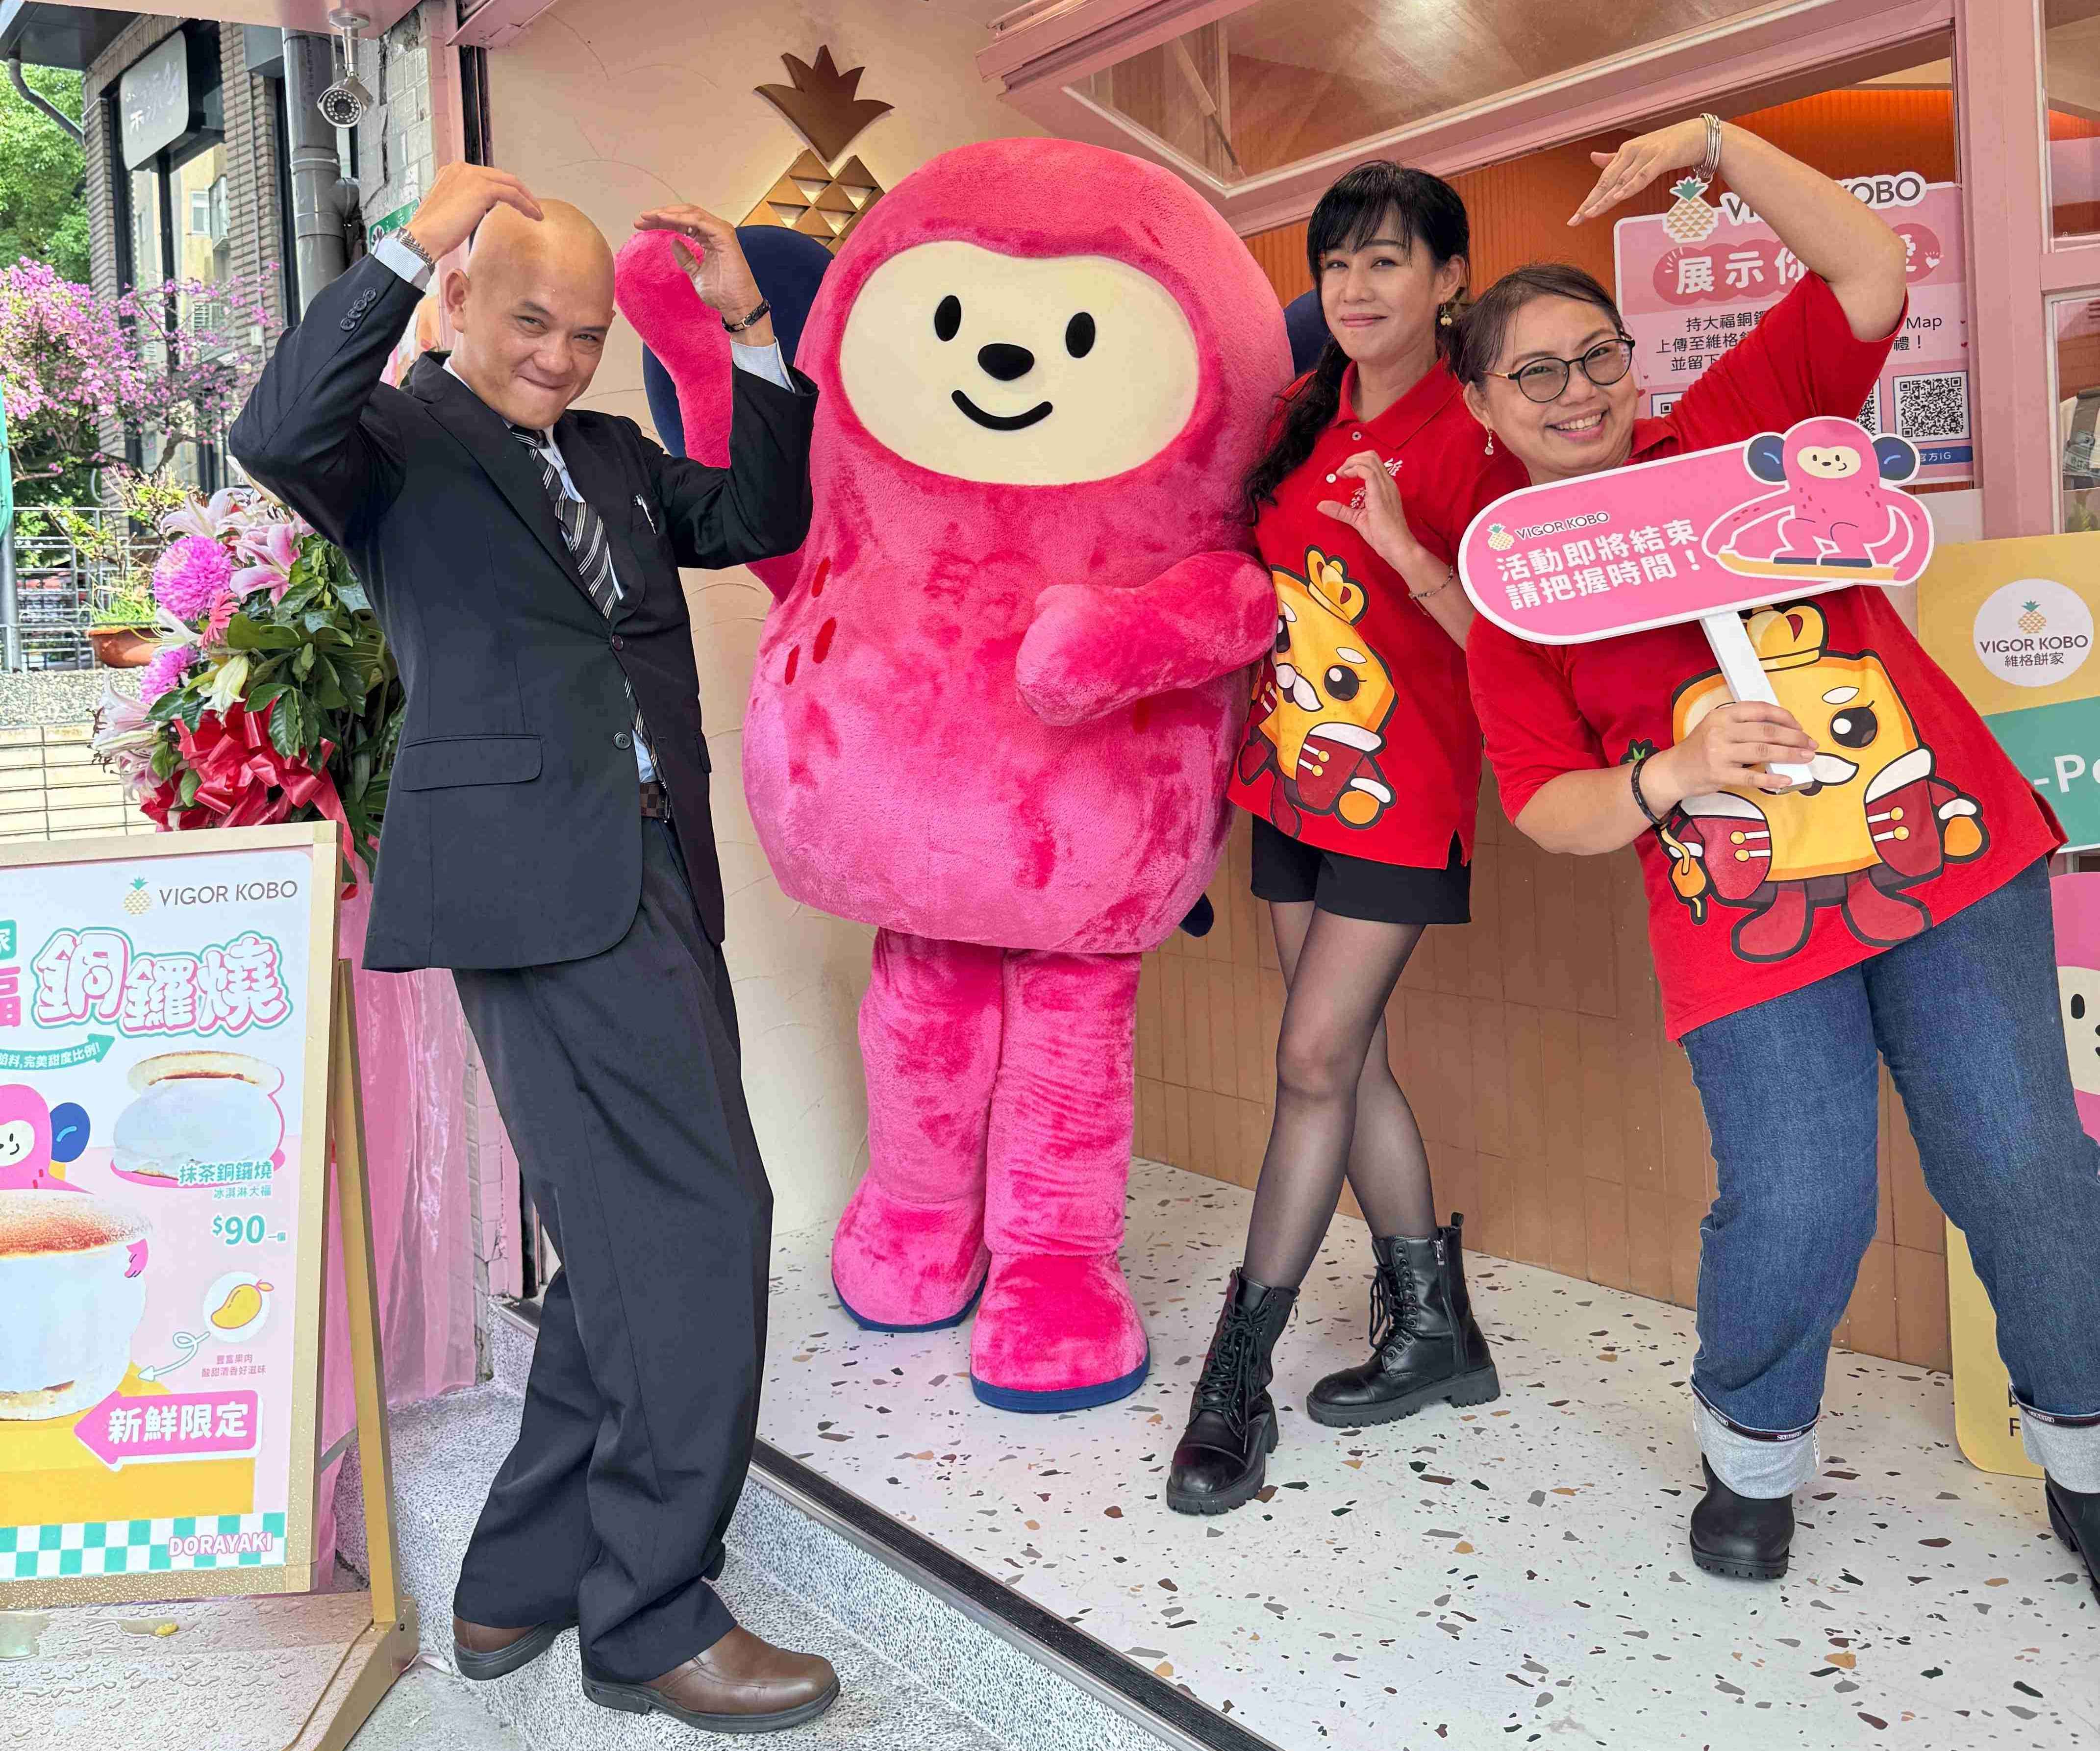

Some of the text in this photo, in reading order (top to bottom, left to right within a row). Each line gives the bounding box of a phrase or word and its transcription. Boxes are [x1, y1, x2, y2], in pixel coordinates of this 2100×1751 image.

[1843, 177, 1921, 205] OBO
[1907, 316, 1942, 330] Map
[1516, 512, 1608, 539] VIGOR KOBO
[1496, 519, 1699, 581] 活動即將結束
[1980, 635, 2088, 653] VIGOR KOBO
[2005, 652, 2064, 667] 維格餅家
[159, 880, 298, 906] VIGOR KOBO
[179, 1161, 273, 1183] 抹茶銅鑼燒
[108, 1401, 248, 1444] 新鮮限定
[169, 1532, 273, 1557] DORAYAKI
